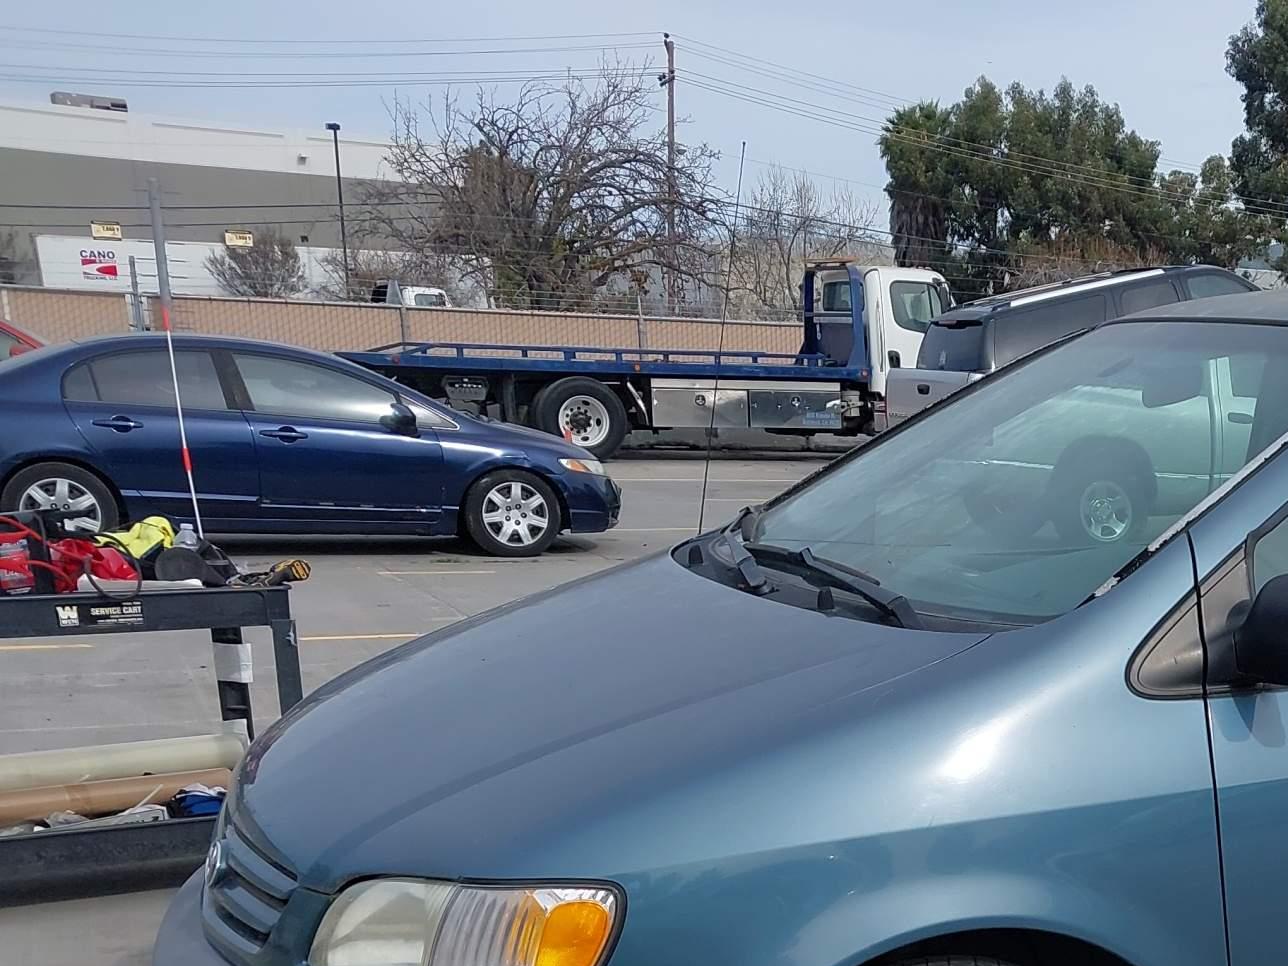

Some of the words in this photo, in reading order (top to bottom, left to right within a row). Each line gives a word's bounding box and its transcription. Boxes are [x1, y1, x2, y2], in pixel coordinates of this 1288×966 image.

[80, 249, 115, 259] CANO
[90, 606, 121, 616] SERVICE
[122, 605, 142, 614] CART
